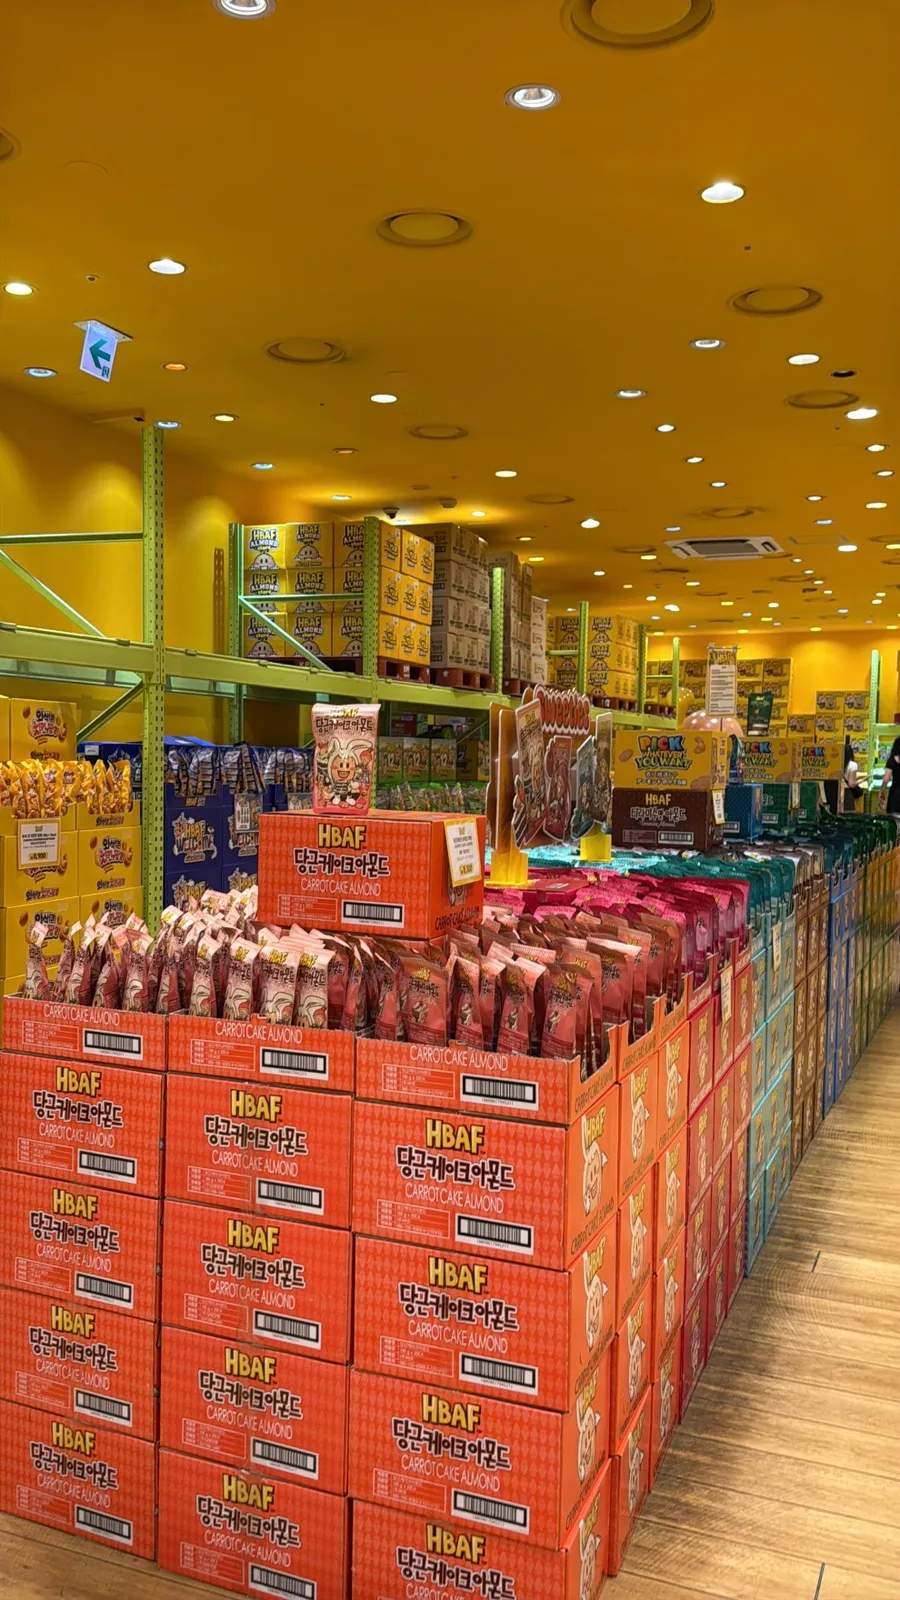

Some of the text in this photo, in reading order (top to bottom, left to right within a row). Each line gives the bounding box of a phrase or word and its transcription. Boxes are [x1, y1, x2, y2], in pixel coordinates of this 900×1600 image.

[250, 540, 278, 551] ALMOND
[252, 529, 277, 541] HBAF
[638, 736, 684, 752] PICK
[636, 758, 691, 769] YOU WANT
[645, 793, 671, 806] HBAF
[317, 823, 367, 849] HBAF
[293, 848, 390, 879] 당근케이크아몬드
[301, 877, 381, 897] CARROT CAKE ALMOND
[44, 1004, 119, 1026] CARROT CAKE ALMOND
[215, 1021, 302, 1044] CARROT CAKE ALMOND
[409, 1046, 508, 1072] CARROT CAKE ALMOND
[56, 1067, 102, 1097] HBAF
[32, 1090, 124, 1128] 당근케이크아몬드
[230, 1089, 282, 1123] HBAF
[39, 1123, 115, 1149] CARROT CAKE ALMOND
[203, 1115, 308, 1157] 당근케이크아몬드
[426, 1118, 484, 1155] HBAF
[212, 1150, 298, 1177] CARROT CAKE ALMOND
[396, 1145, 516, 1192] 당근케이크아몬드
[52, 1188, 98, 1221] HBAF
[405, 1183, 504, 1213] CARROT CAKE ALMOND
[29, 1210, 120, 1254] 당근케이크아몬드
[227, 1218, 280, 1255] HBAF
[36, 1243, 112, 1272] CARROT CAKE ALMOND
[200, 1243, 306, 1289] 당근케이크아몬드
[428, 1256, 488, 1295] HBAF
[209, 1279, 295, 1310] CARROT CAKE ALMOND
[398, 1282, 520, 1332] 당근케이크아몬드
[51, 1305, 96, 1339] HBAF
[408, 1320, 508, 1355] CARROT CAKE ALMOND
[28, 1325, 119, 1372] 당근케이크아몬드
[224, 1347, 277, 1385] HBAF
[36, 1358, 110, 1391] CARROT CAKE ALMOND
[198, 1369, 304, 1420] 당근케이크아몬드
[206, 1405, 293, 1440] CARROT CAKE ALMOND
[422, 1392, 481, 1434] HBAF
[51, 1421, 96, 1456] HBAF
[391, 1416, 512, 1470] 당근케이크아몬드
[29, 1440, 119, 1490] 당근케이크아몬드
[401, 1455, 500, 1492] CARROT CAKE ALMOND
[37, 1474, 111, 1509] CARROT CAKE ALMOND
[222, 1473, 275, 1512] HBAF
[196, 1494, 301, 1548] 당근케이크아몬드
[204, 1530, 292, 1568] CARROT CAKE ALMOND
[426, 1522, 486, 1565] HBAF
[396, 1546, 516, 1600] 당근케이크아몬드
